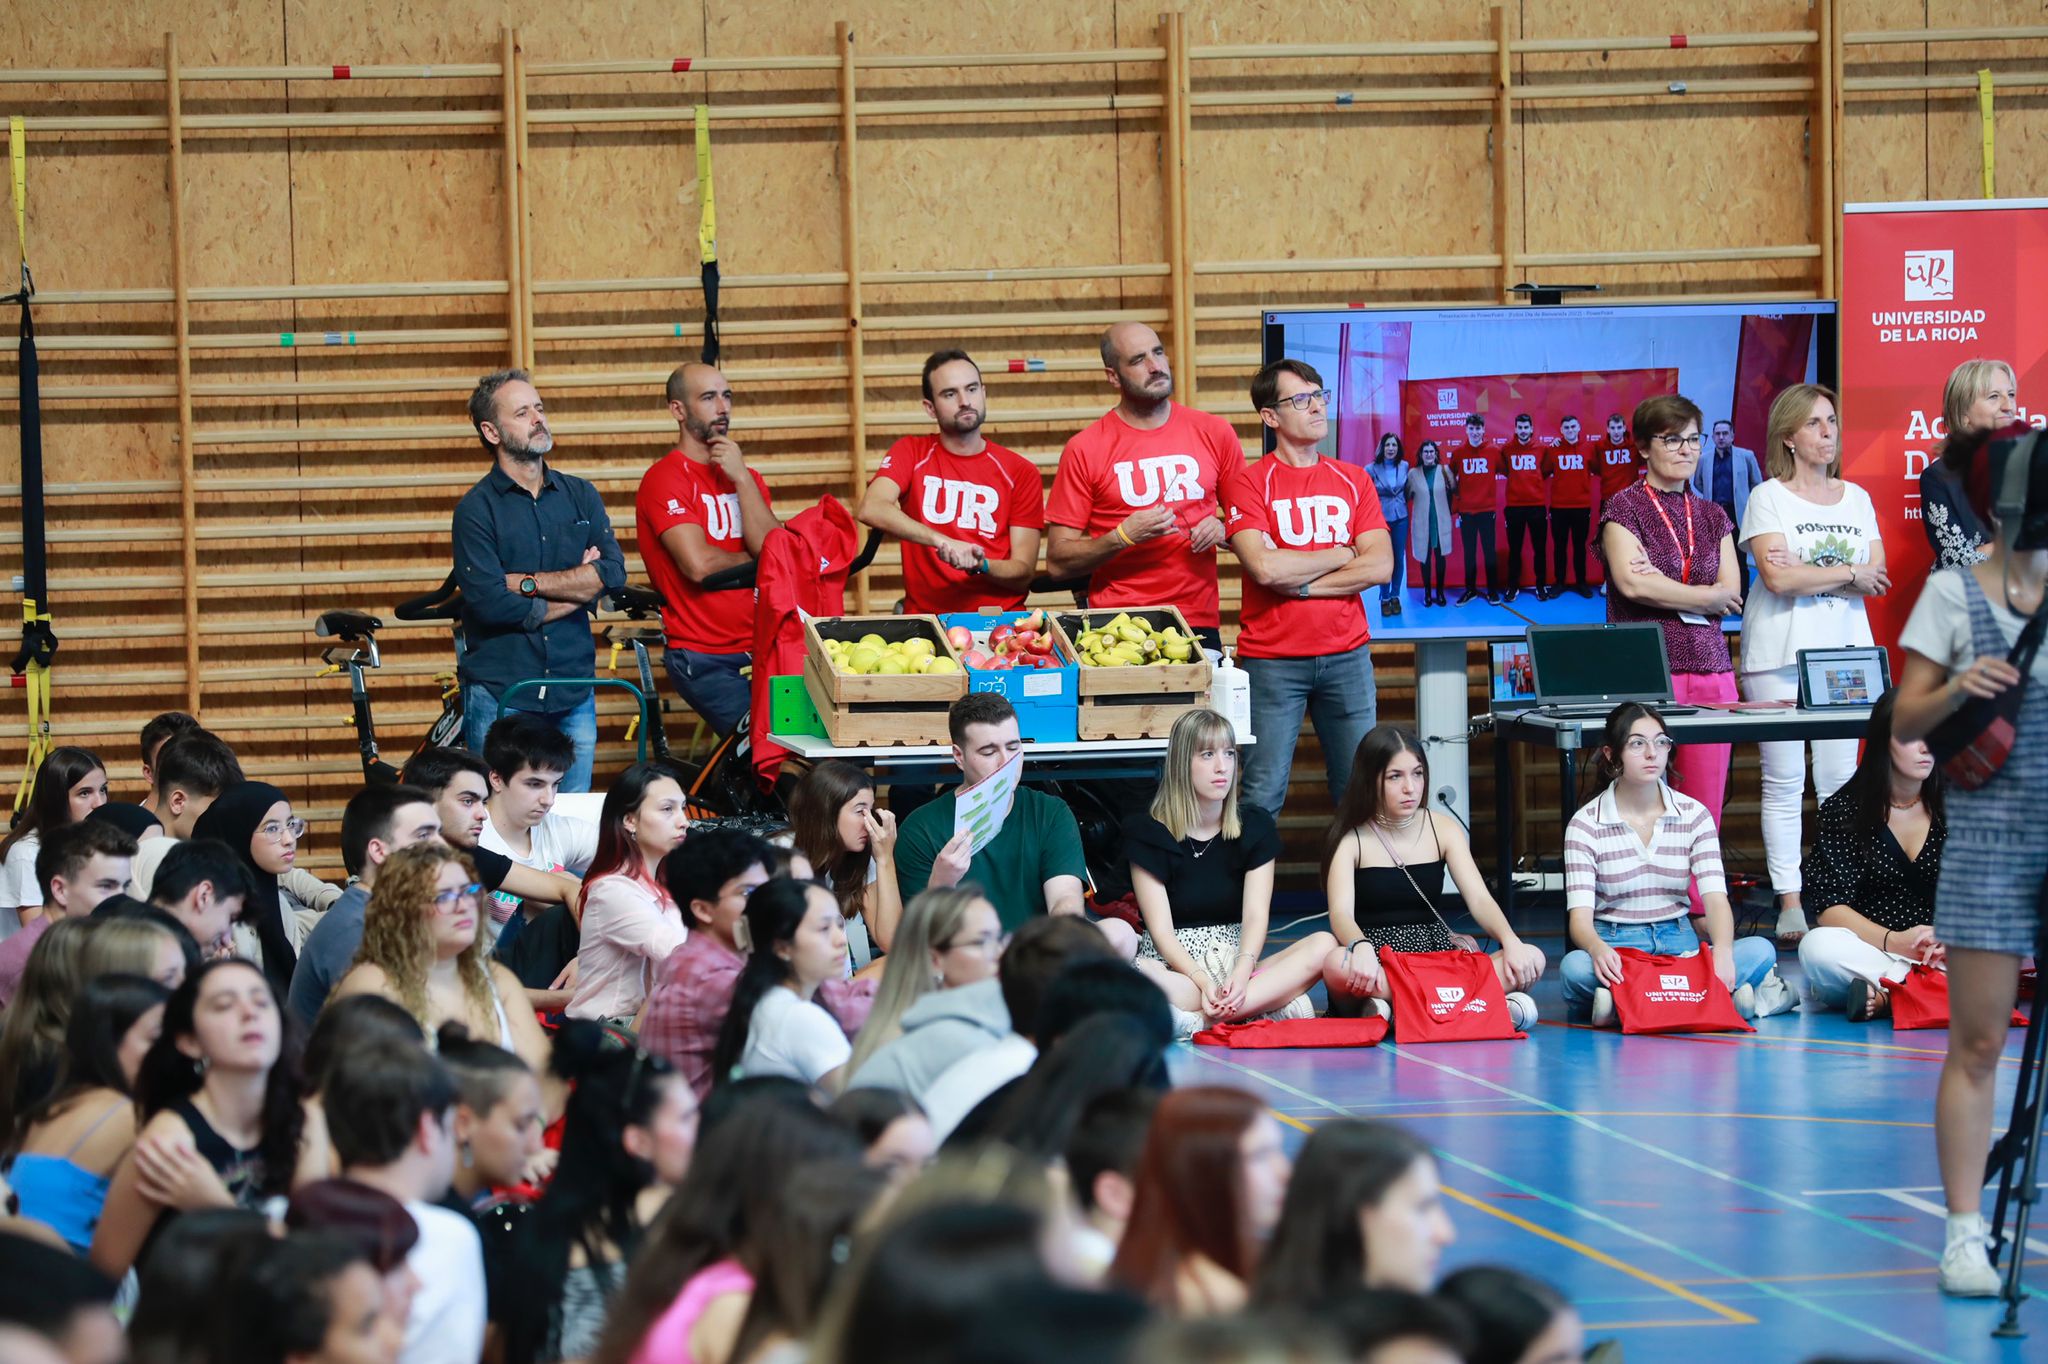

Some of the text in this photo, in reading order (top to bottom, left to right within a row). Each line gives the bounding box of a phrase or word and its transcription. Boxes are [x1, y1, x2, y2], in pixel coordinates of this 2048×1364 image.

[1871, 309, 1986, 326] UNIVERSIDAD
[1880, 327, 1978, 344] DE LA RIOJA
[1511, 454, 1537, 471] UR
[1558, 454, 1584, 471] UR
[1605, 449, 1632, 465] UR
[1462, 457, 1489, 475] UR
[1113, 454, 1205, 508] UR
[922, 474, 999, 534] UR
[1271, 494, 1351, 547] UR
[1795, 522, 1862, 537] POSITIVE
